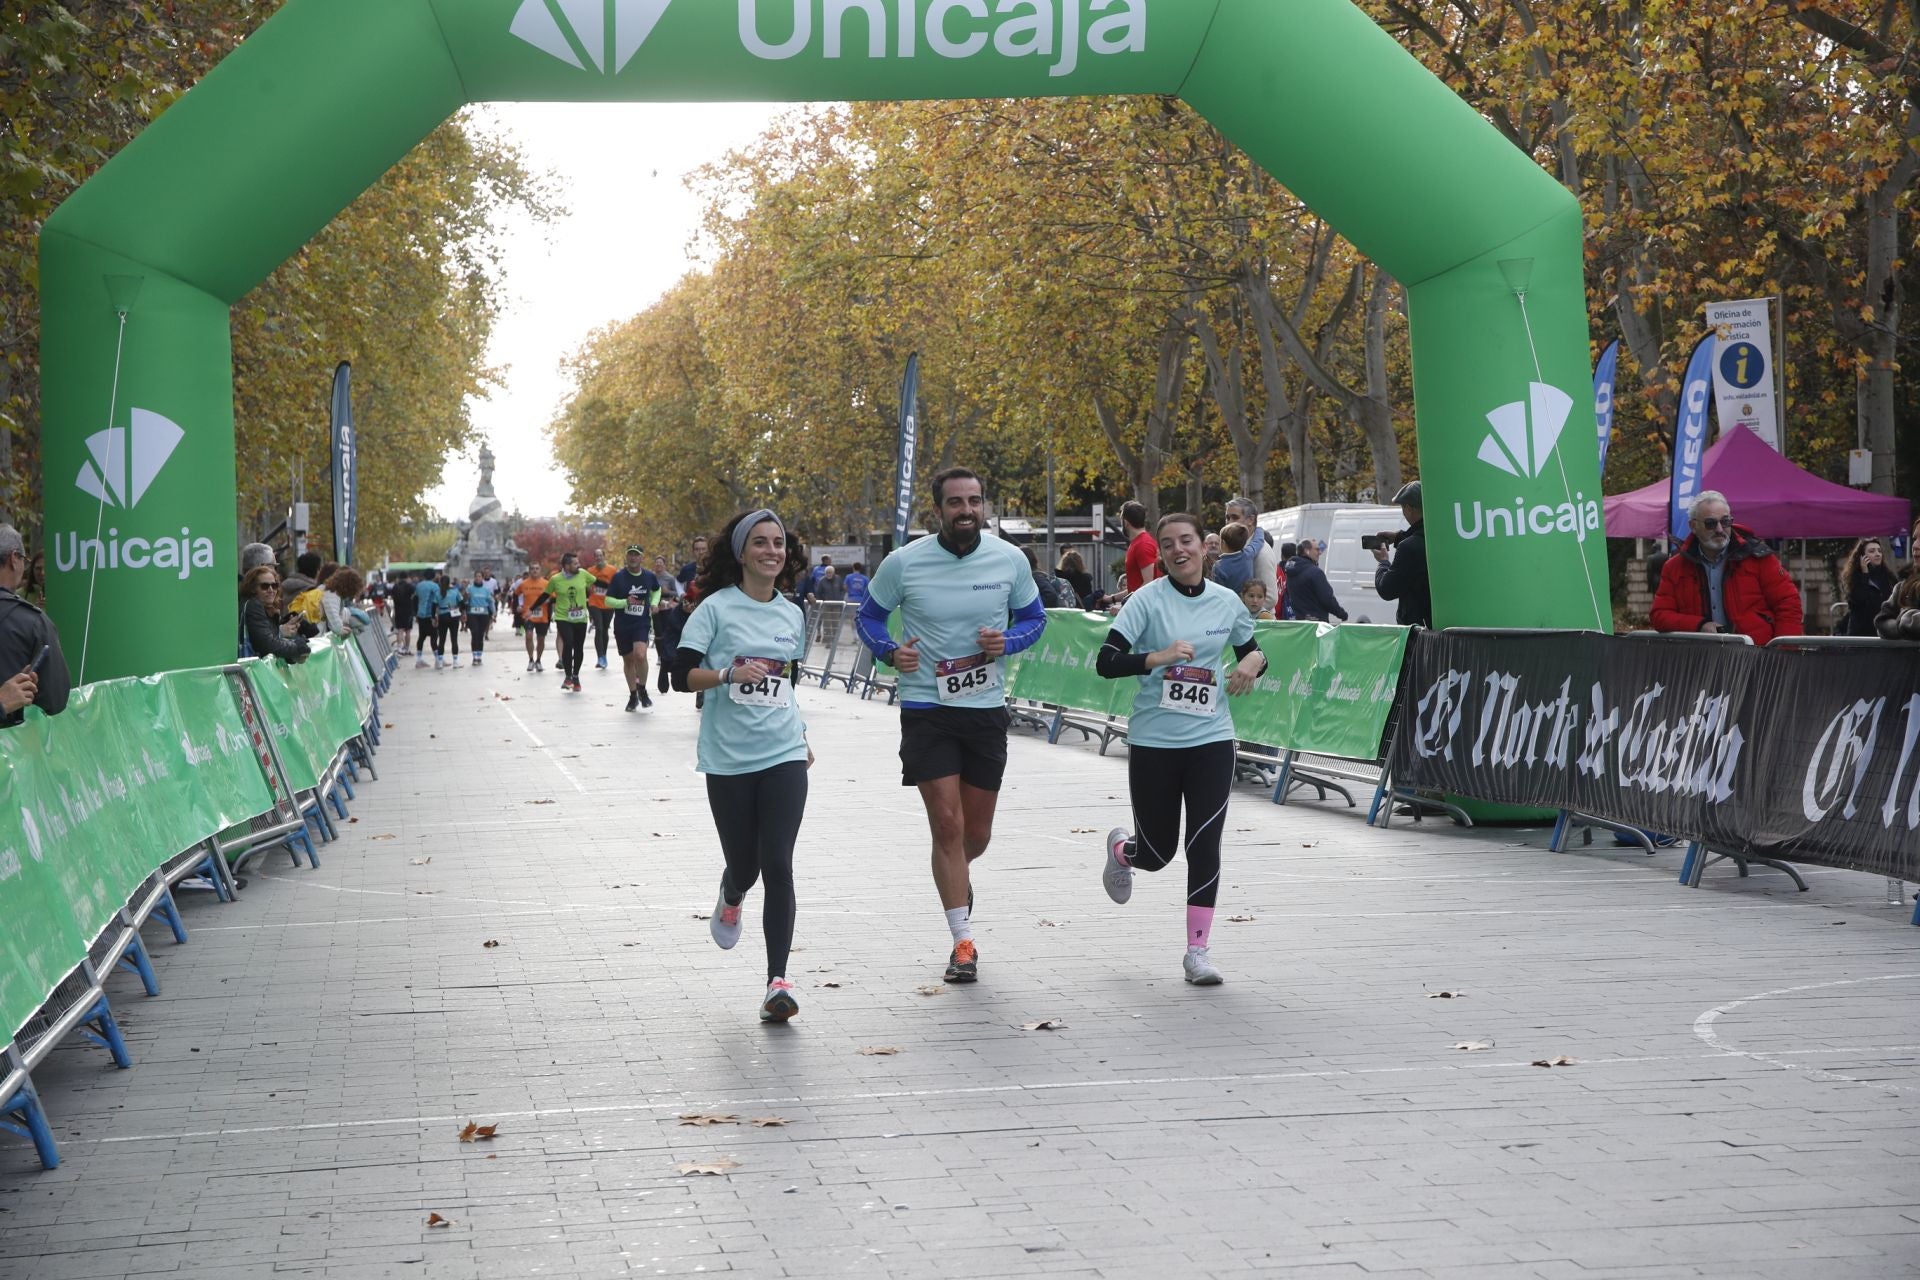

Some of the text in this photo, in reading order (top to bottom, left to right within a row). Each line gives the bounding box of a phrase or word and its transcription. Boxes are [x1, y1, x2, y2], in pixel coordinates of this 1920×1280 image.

[738, 0, 1147, 77] Unicaja
[1714, 308, 1752, 319] Oficina de
[1678, 379, 1707, 510] IVECO
[897, 415, 914, 532] Unicaja
[1454, 491, 1599, 543] Unicaja
[55, 526, 213, 580] Unicaja
[739, 676, 781, 697] 847
[946, 667, 988, 694] 845
[1169, 682, 1210, 705] 846
[1472, 670, 1579, 770] Norte
[1802, 696, 1888, 823] El
